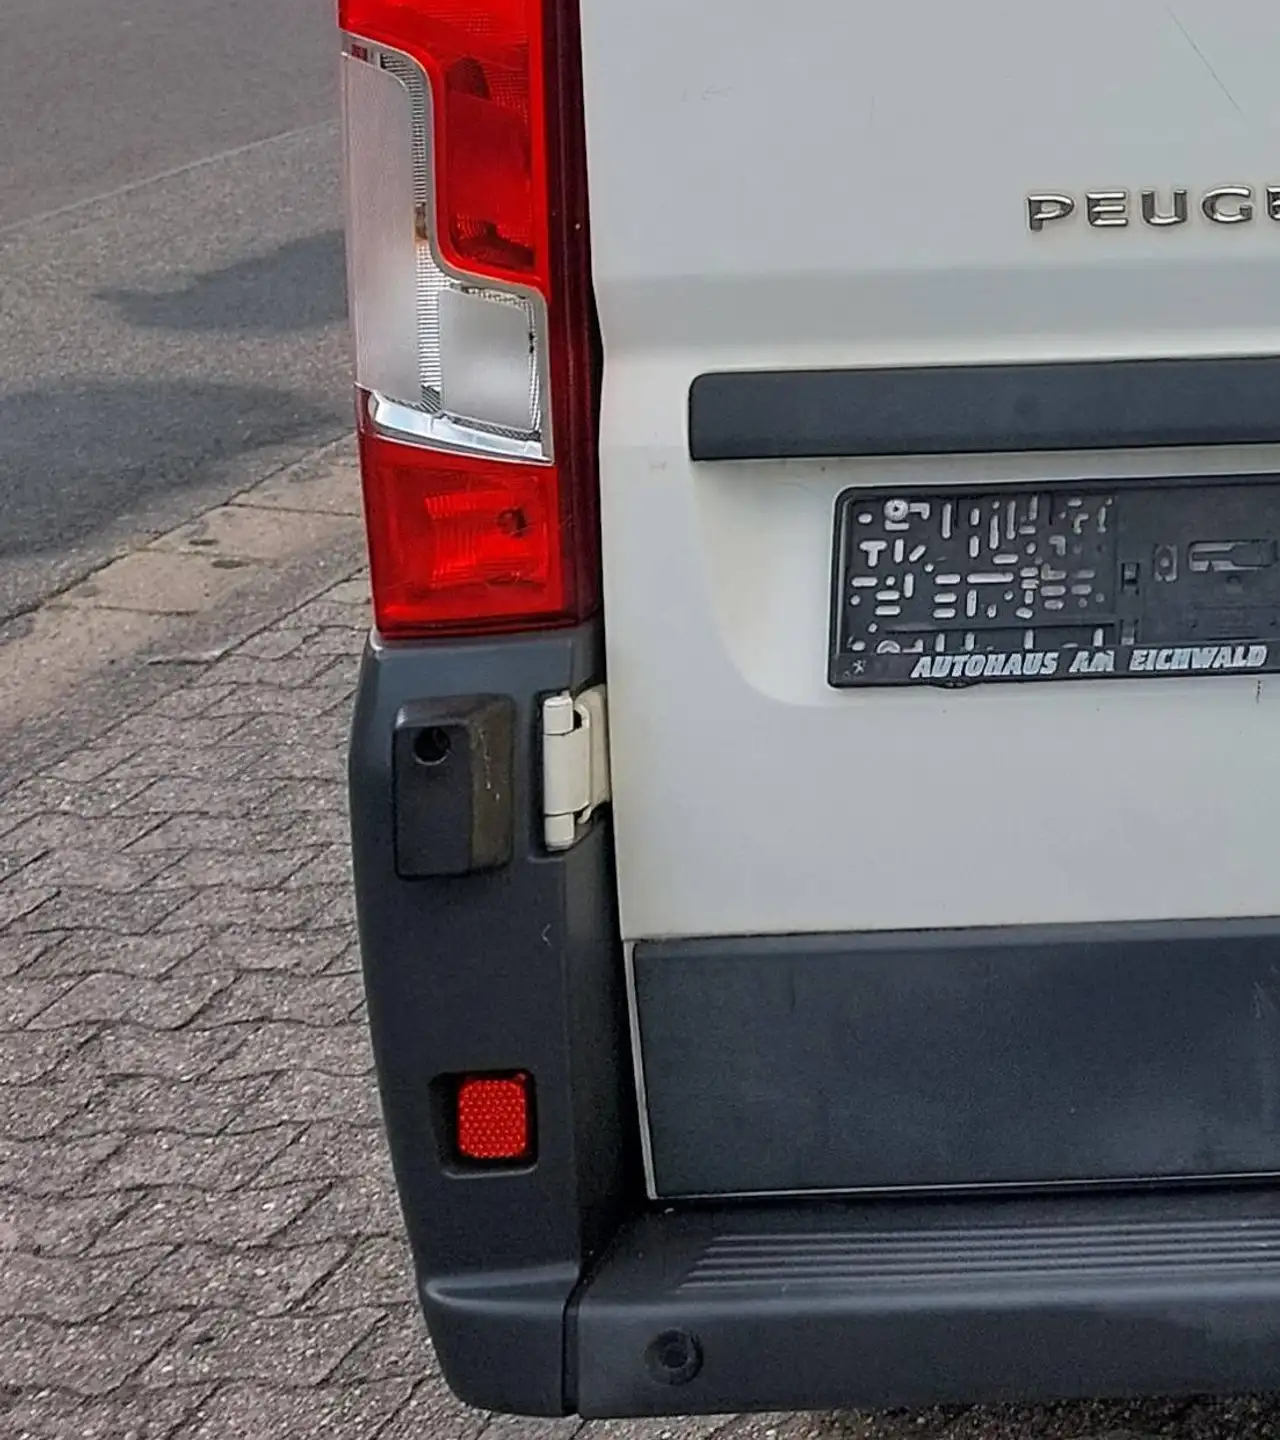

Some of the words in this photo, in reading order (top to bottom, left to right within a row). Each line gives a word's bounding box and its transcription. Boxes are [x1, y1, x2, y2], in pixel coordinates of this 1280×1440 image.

[910, 652, 1060, 679] AUTOHAUS
[1068, 649, 1116, 673] AM
[1129, 644, 1268, 672] EICHWALD
